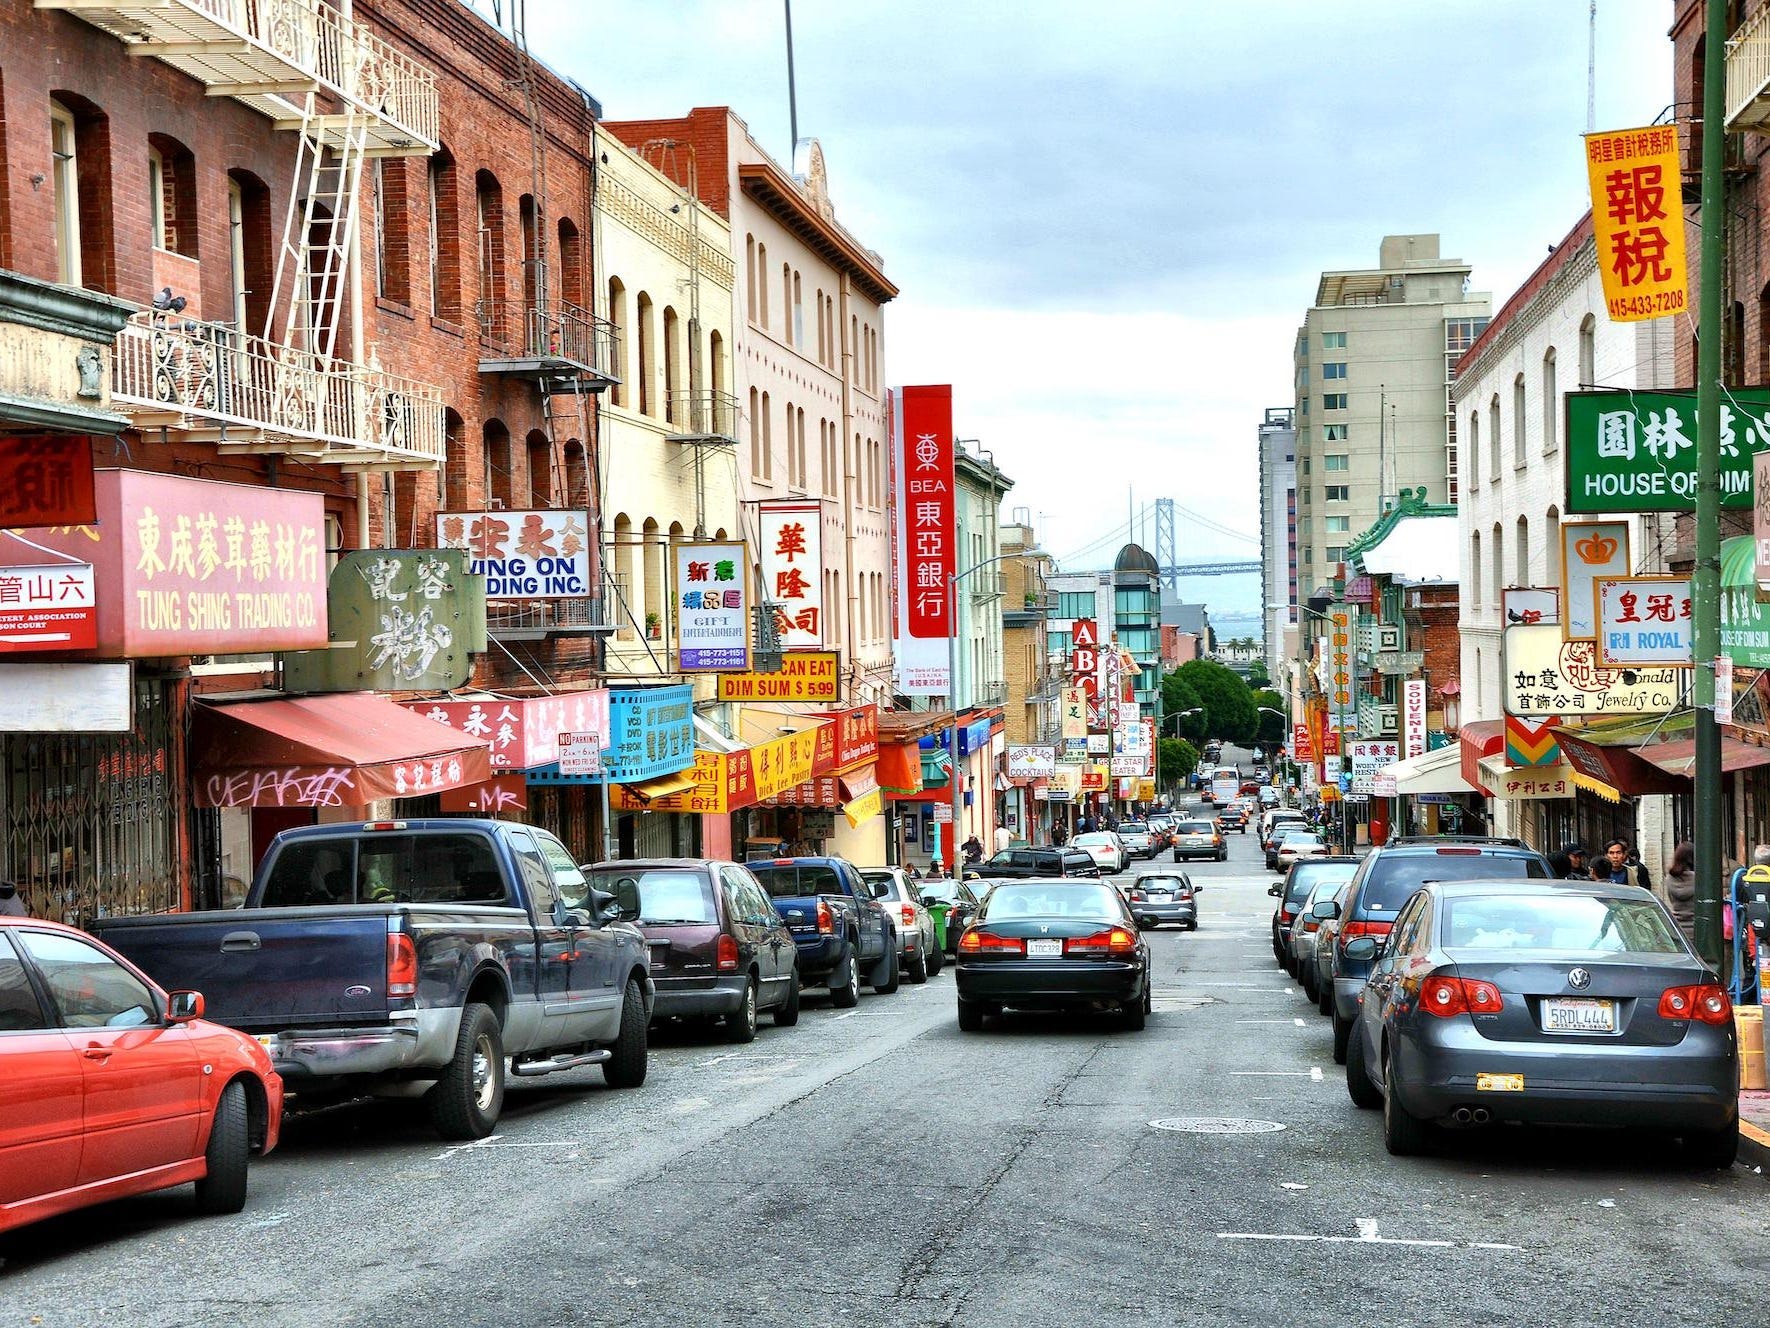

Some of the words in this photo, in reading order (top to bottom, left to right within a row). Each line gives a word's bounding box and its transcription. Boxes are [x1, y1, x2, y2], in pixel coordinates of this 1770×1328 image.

[1609, 289, 1685, 319] 415-433-7208
[909, 479, 947, 494] BEA
[1584, 471, 1666, 498] HOUSE
[535, 556, 575, 576] ON
[915, 500, 945, 618] 東亞銀行
[545, 575, 587, 595] INC.
[27, 612, 88, 622] ASSOCIATION
[136, 588, 182, 632] TUNG
[187, 590, 232, 632] SHING
[234, 590, 292, 631] TRADING
[295, 592, 317, 629] CO.
[16, 621, 48, 630] COURT
[693, 616, 732, 626] GIFT
[682, 627, 743, 638] ENTERTAINMENT
[1637, 631, 1684, 650] ROYAL
[780, 659, 807, 677] CAN
[809, 659, 835, 677] EAT
[1621, 667, 1675, 687] onald
[725, 679, 754, 697] DIM
[757, 679, 791, 697] SUM
[795, 679, 804, 695] $
[807, 680, 835, 697] 5.99
[1514, 667, 1560, 691] 如意
[1517, 692, 1586, 711] 首飾公司
[1596, 690, 1647, 712] Jewelry
[1651, 692, 1672, 707] Co.
[559, 733, 571, 745] NO
[572, 735, 598, 744] PARKING
[626, 729, 643, 739] DVD
[1009, 747, 1029, 763] RED'S
[1031, 747, 1054, 762] PLACE
[1098, 757, 1121, 766] GRAT
[1010, 768, 1054, 778] COCKTAILS
[1110, 766, 1137, 775] HEATER
[1559, 1000, 1599, 1009] California
